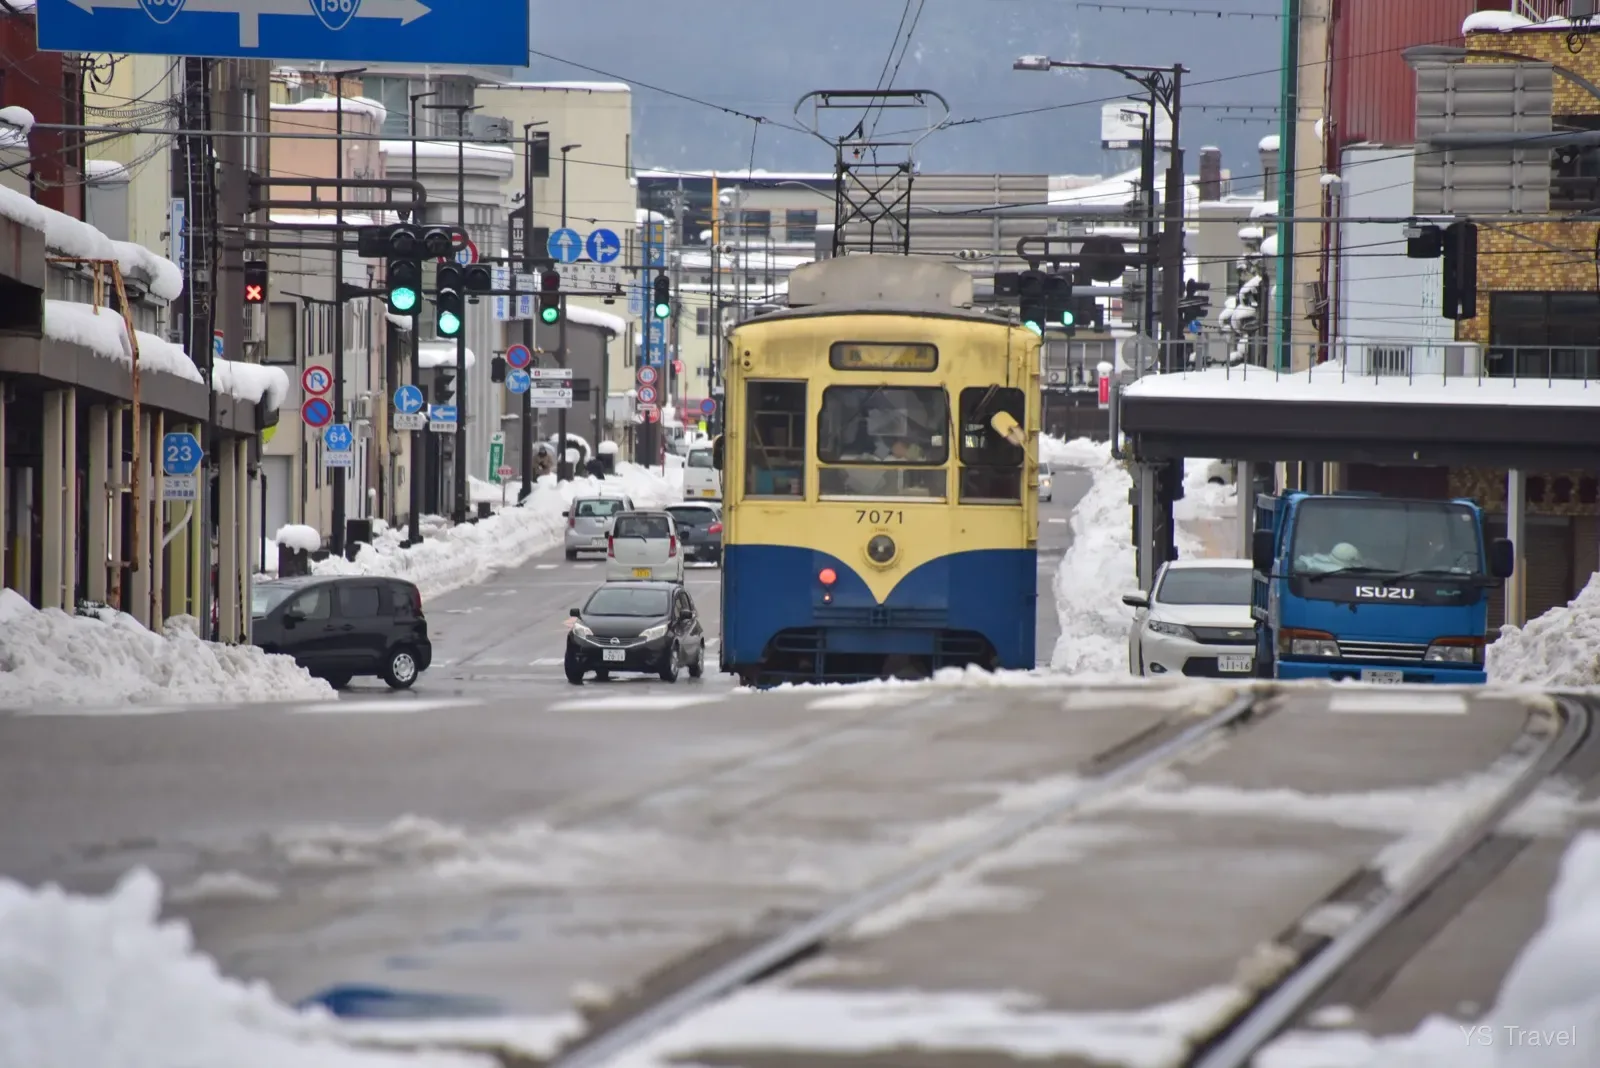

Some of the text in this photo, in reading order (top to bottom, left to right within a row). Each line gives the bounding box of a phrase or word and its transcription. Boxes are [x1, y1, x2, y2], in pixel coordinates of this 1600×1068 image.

[321, 0, 352, 13] 156
[330, 432, 347, 443] 64
[167, 445, 192, 462] 23
[855, 509, 904, 524] 7071
[1355, 586, 1415, 599] ISUZU
